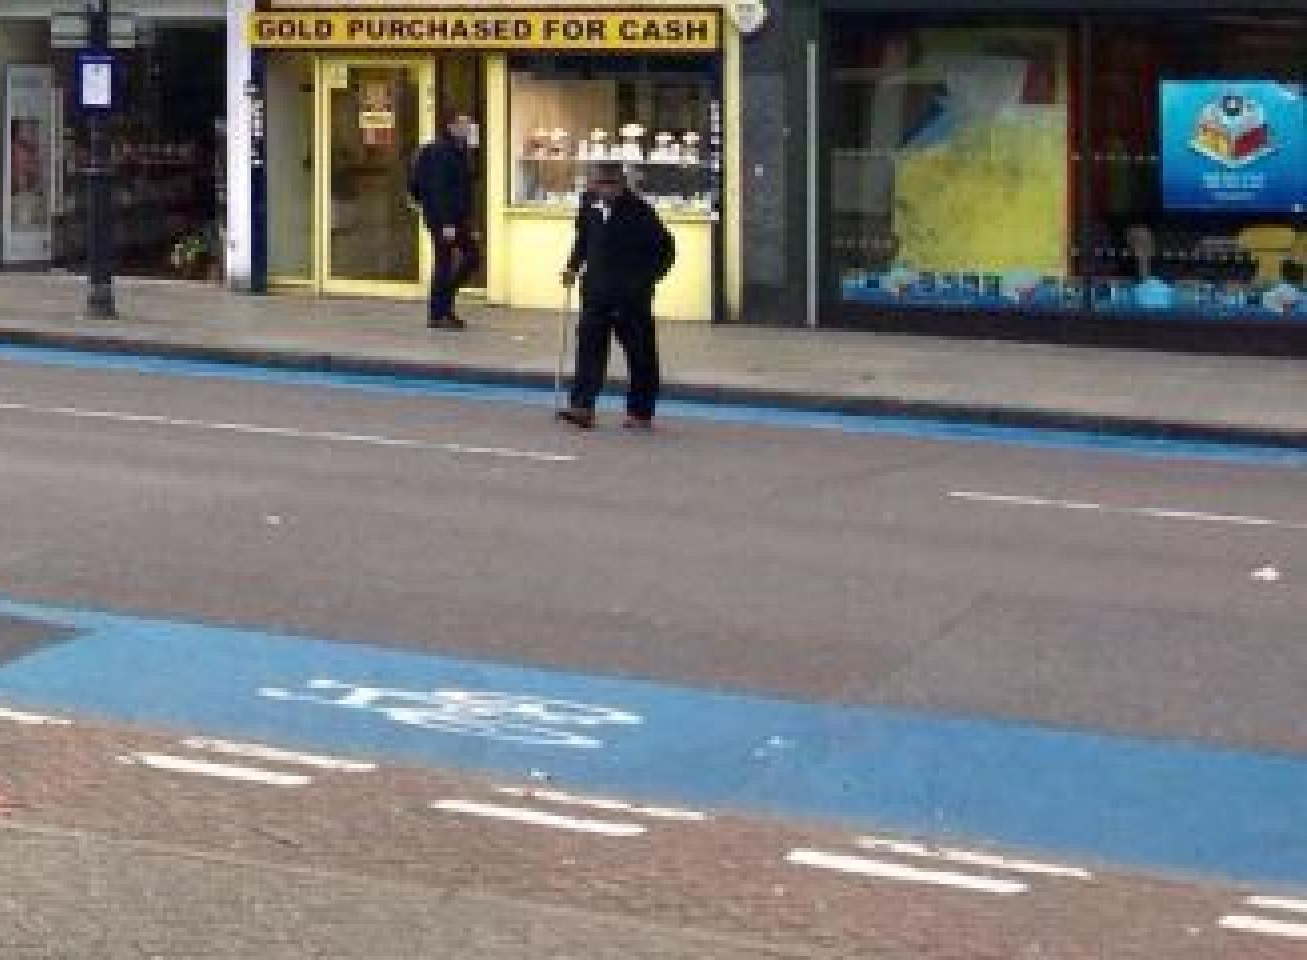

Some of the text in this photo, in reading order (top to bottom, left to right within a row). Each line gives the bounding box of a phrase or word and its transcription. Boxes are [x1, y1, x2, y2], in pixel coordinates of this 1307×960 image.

[256, 19, 709, 41] GOLD PURCHASED FOR CASH
